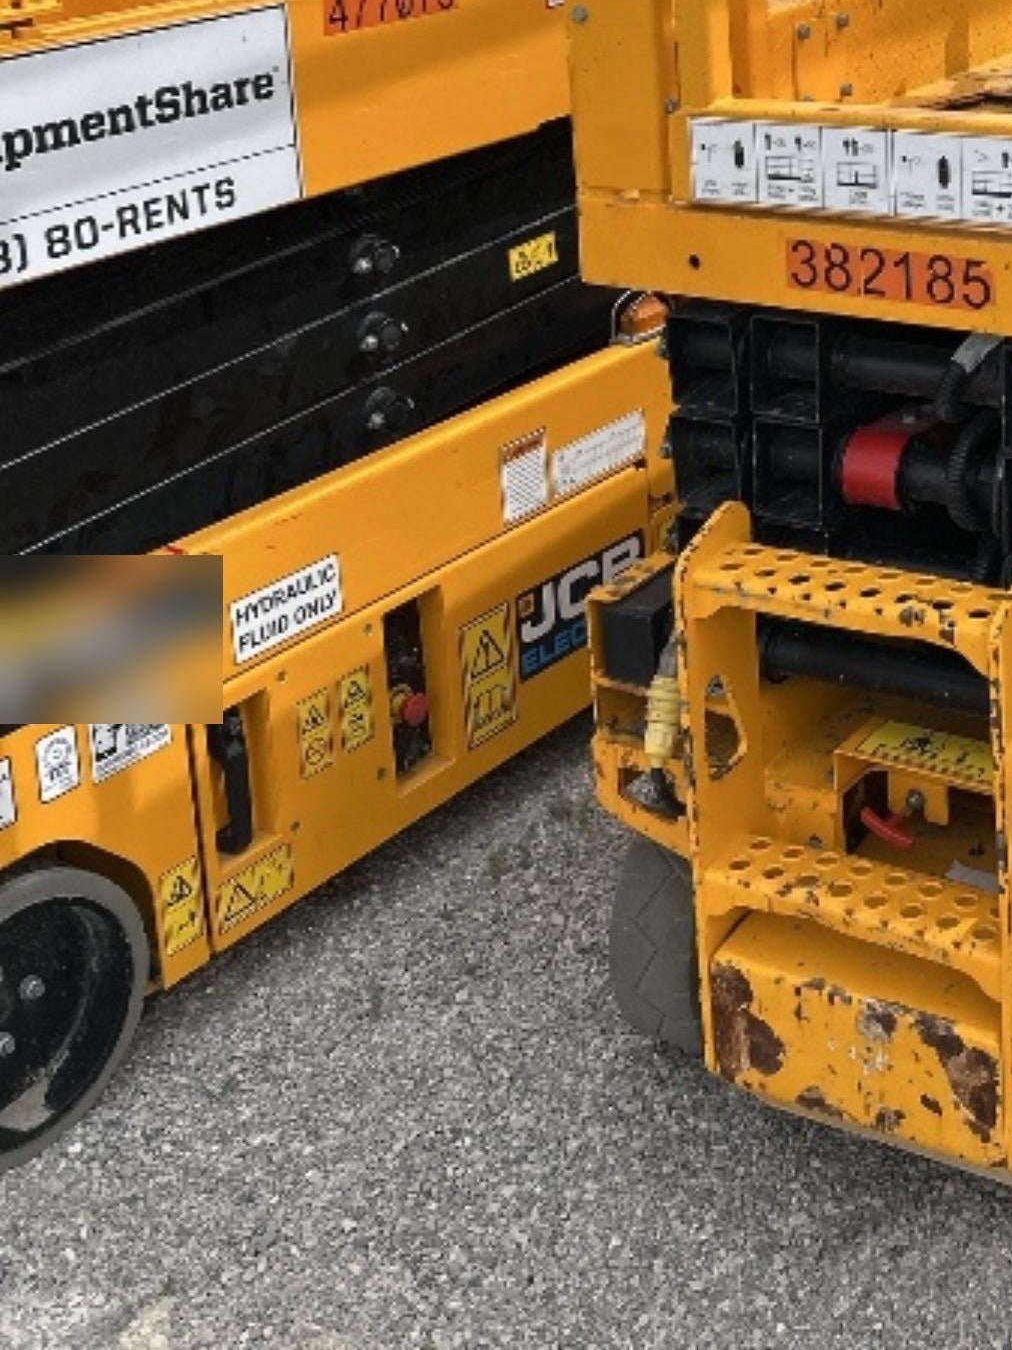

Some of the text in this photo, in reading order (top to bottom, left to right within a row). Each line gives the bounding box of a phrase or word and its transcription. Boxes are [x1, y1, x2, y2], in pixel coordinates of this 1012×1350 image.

[0, 72, 275, 171] pmentShare
[45, 177, 236, 258] 80-RENTS
[791, 240, 991, 309] 382185
[236, 563, 336, 627] HYDRAULIC
[239, 588, 336, 652] FLUID ONLY
